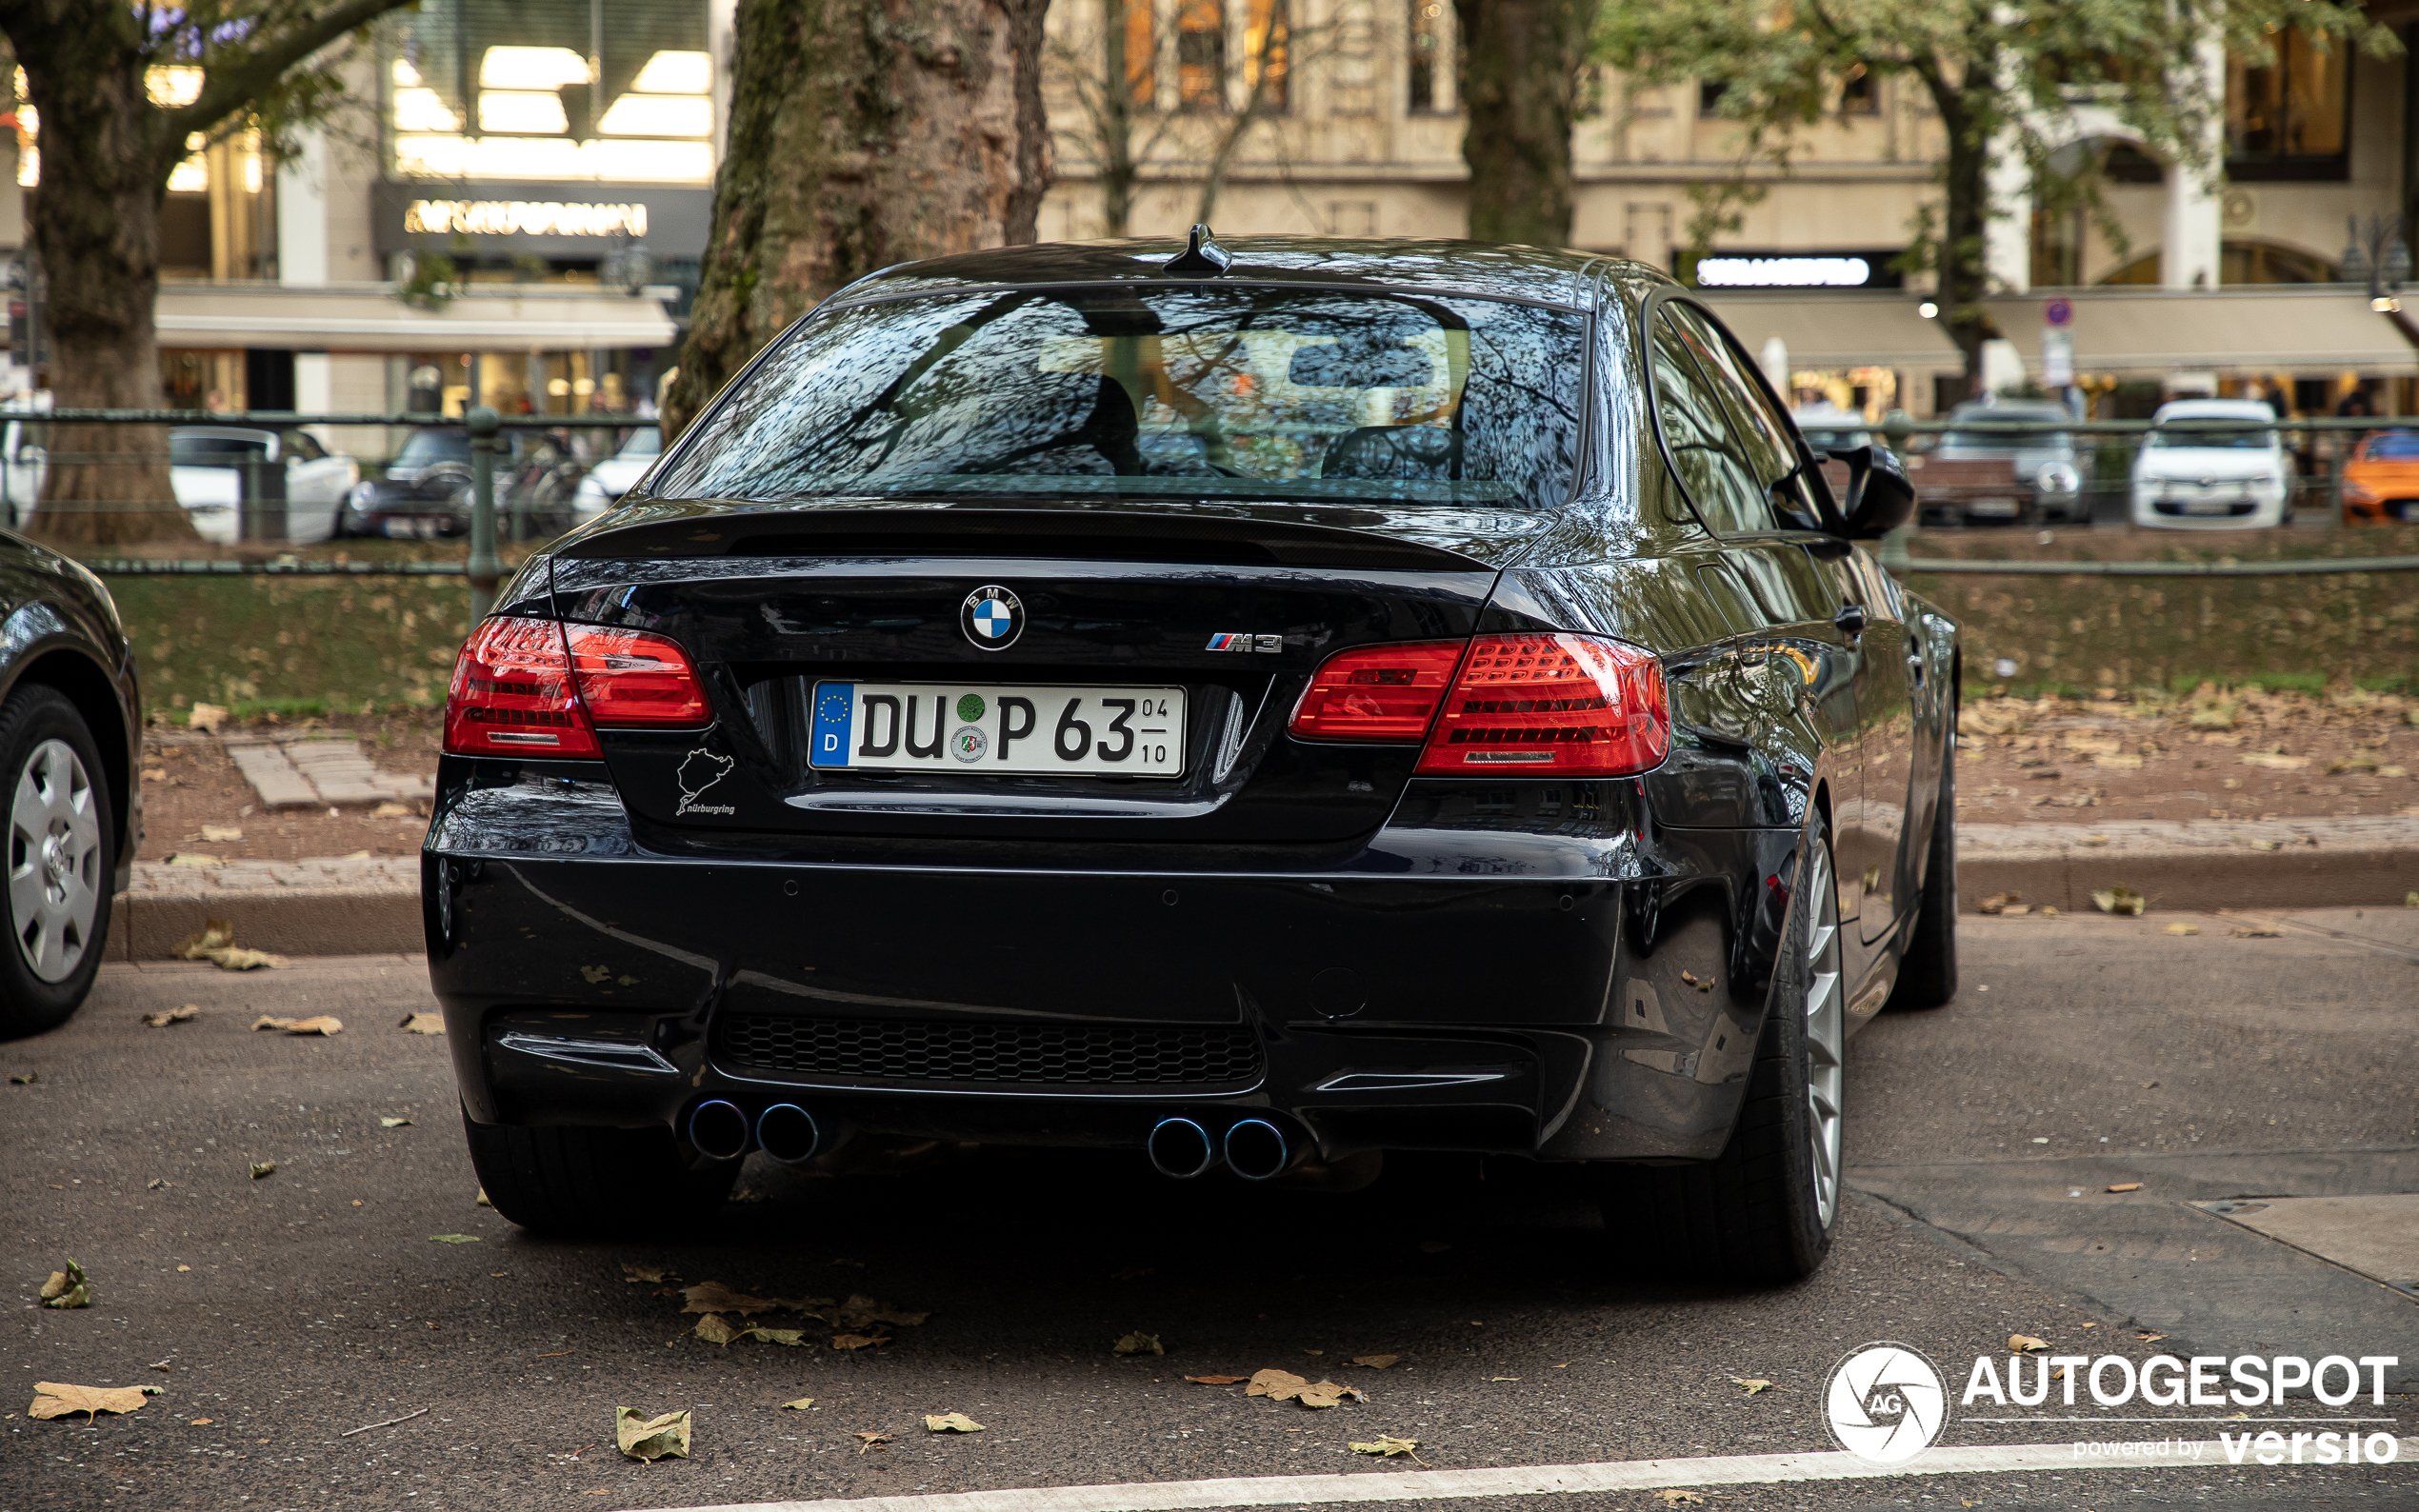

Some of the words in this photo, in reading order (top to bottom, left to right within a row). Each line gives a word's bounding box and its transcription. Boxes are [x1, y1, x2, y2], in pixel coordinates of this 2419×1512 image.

[968, 587, 1019, 609] BMW
[1223, 632, 1283, 653] M3
[1142, 698, 1169, 717] 04
[858, 694, 948, 759] DU
[996, 696, 1037, 760] P
[1053, 698, 1136, 762] 63
[824, 733, 839, 752] D
[1142, 744, 1167, 763] 10
[687, 804, 735, 815] nürburgring
